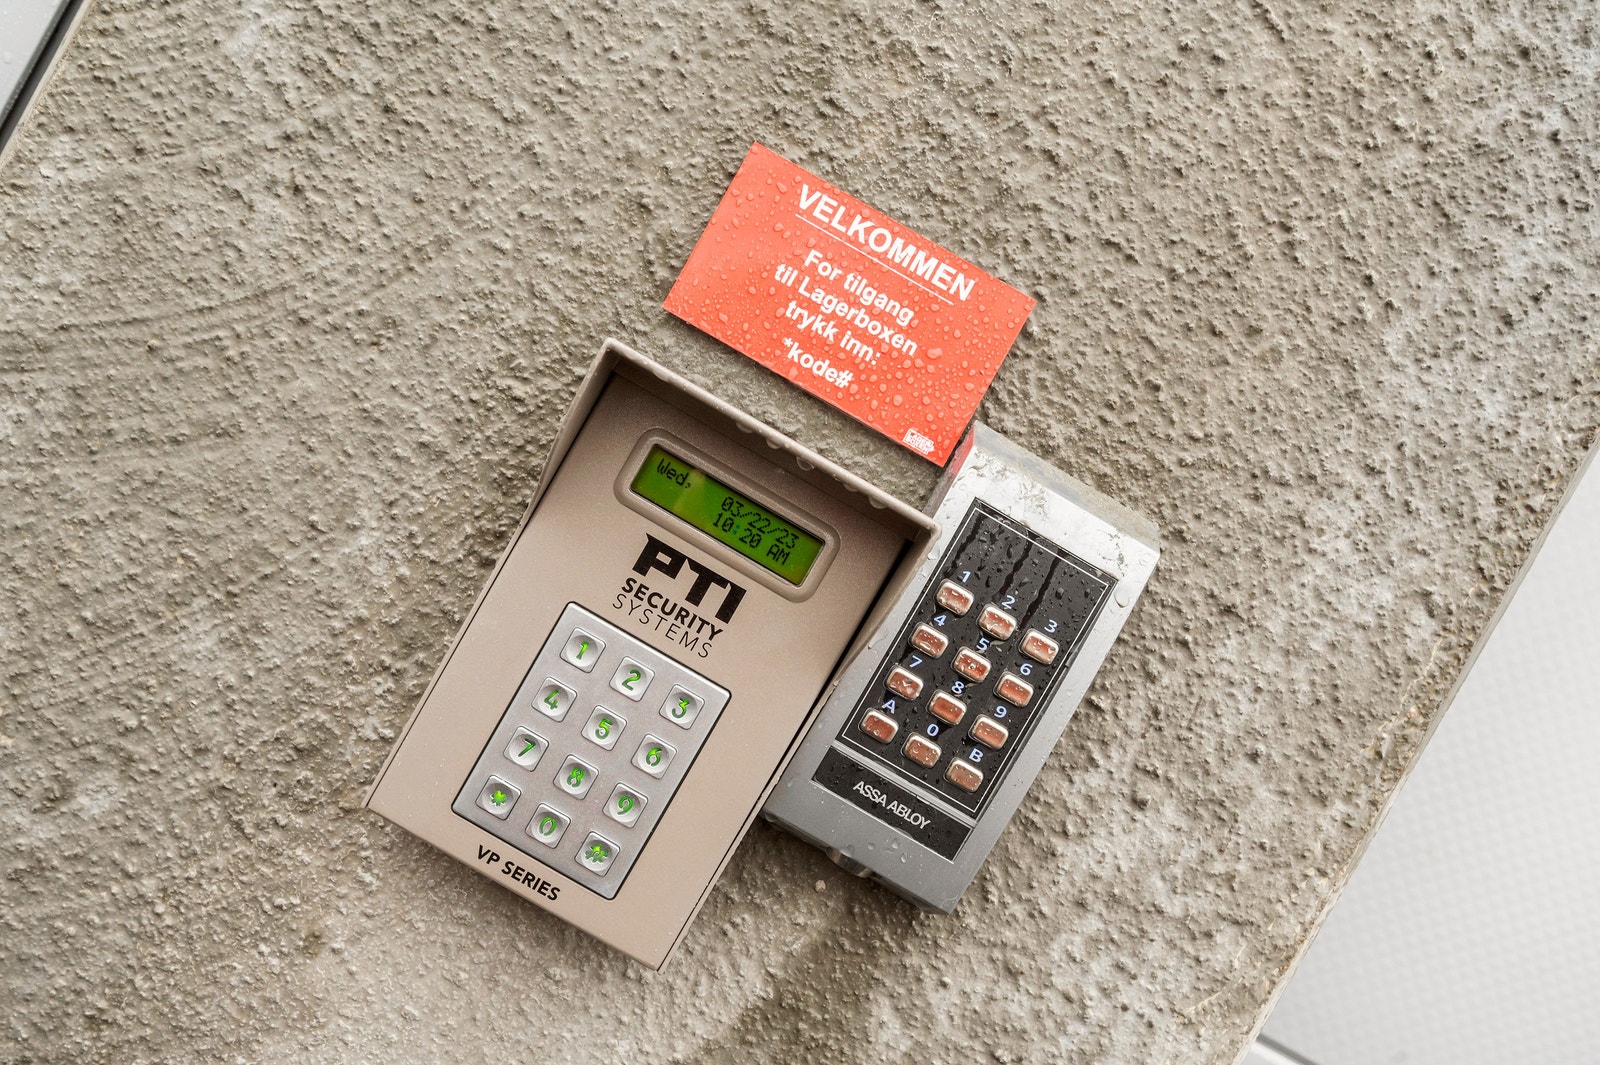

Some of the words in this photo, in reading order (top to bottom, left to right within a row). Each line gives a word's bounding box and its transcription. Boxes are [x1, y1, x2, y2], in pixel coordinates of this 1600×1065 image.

[798, 183, 976, 301] VELKOMMEN
[774, 263, 799, 287] til
[798, 276, 918, 356] Lagerboxen
[804, 249, 843, 281] For
[843, 272, 915, 327] tilgang
[785, 300, 839, 342] trykk
[839, 330, 881, 365] inn:
[656, 458, 692, 489] Wed,
[720, 496, 800, 549] 03/22/23
[712, 512, 762, 549] 10:20
[766, 544, 791, 566] AM
[621, 577, 724, 641] SECURITY
[631, 533, 747, 625] PTI
[962, 570, 972, 583] 1
[1001, 595, 1016, 609] 2
[1044, 619, 1058, 634] 3
[612, 593, 713, 658] SYSTEMS
[933, 614, 947, 627] 4
[976, 637, 990, 651] 5
[1019, 663, 1033, 676] 6
[575, 641, 590, 661] 1
[621, 669, 641, 692] 2
[671, 697, 691, 719] 3
[910, 655, 923, 668] 7
[951, 681, 965, 694] 8
[994, 705, 1008, 718] 9
[543, 689, 559, 710] 4
[594, 717, 614, 740] 5
[645, 747, 663, 768] 6
[881, 699, 897, 714] A
[968, 748, 984, 763] B
[517, 738, 536, 758] 7
[566, 767, 586, 788] 8
[616, 795, 635, 816] 9
[852, 780, 888, 808] ASSA
[886, 800, 932, 831] ABLOY
[538, 816, 558, 837] 0
[476, 844, 501, 867] VP
[501, 861, 561, 901] SERIES
